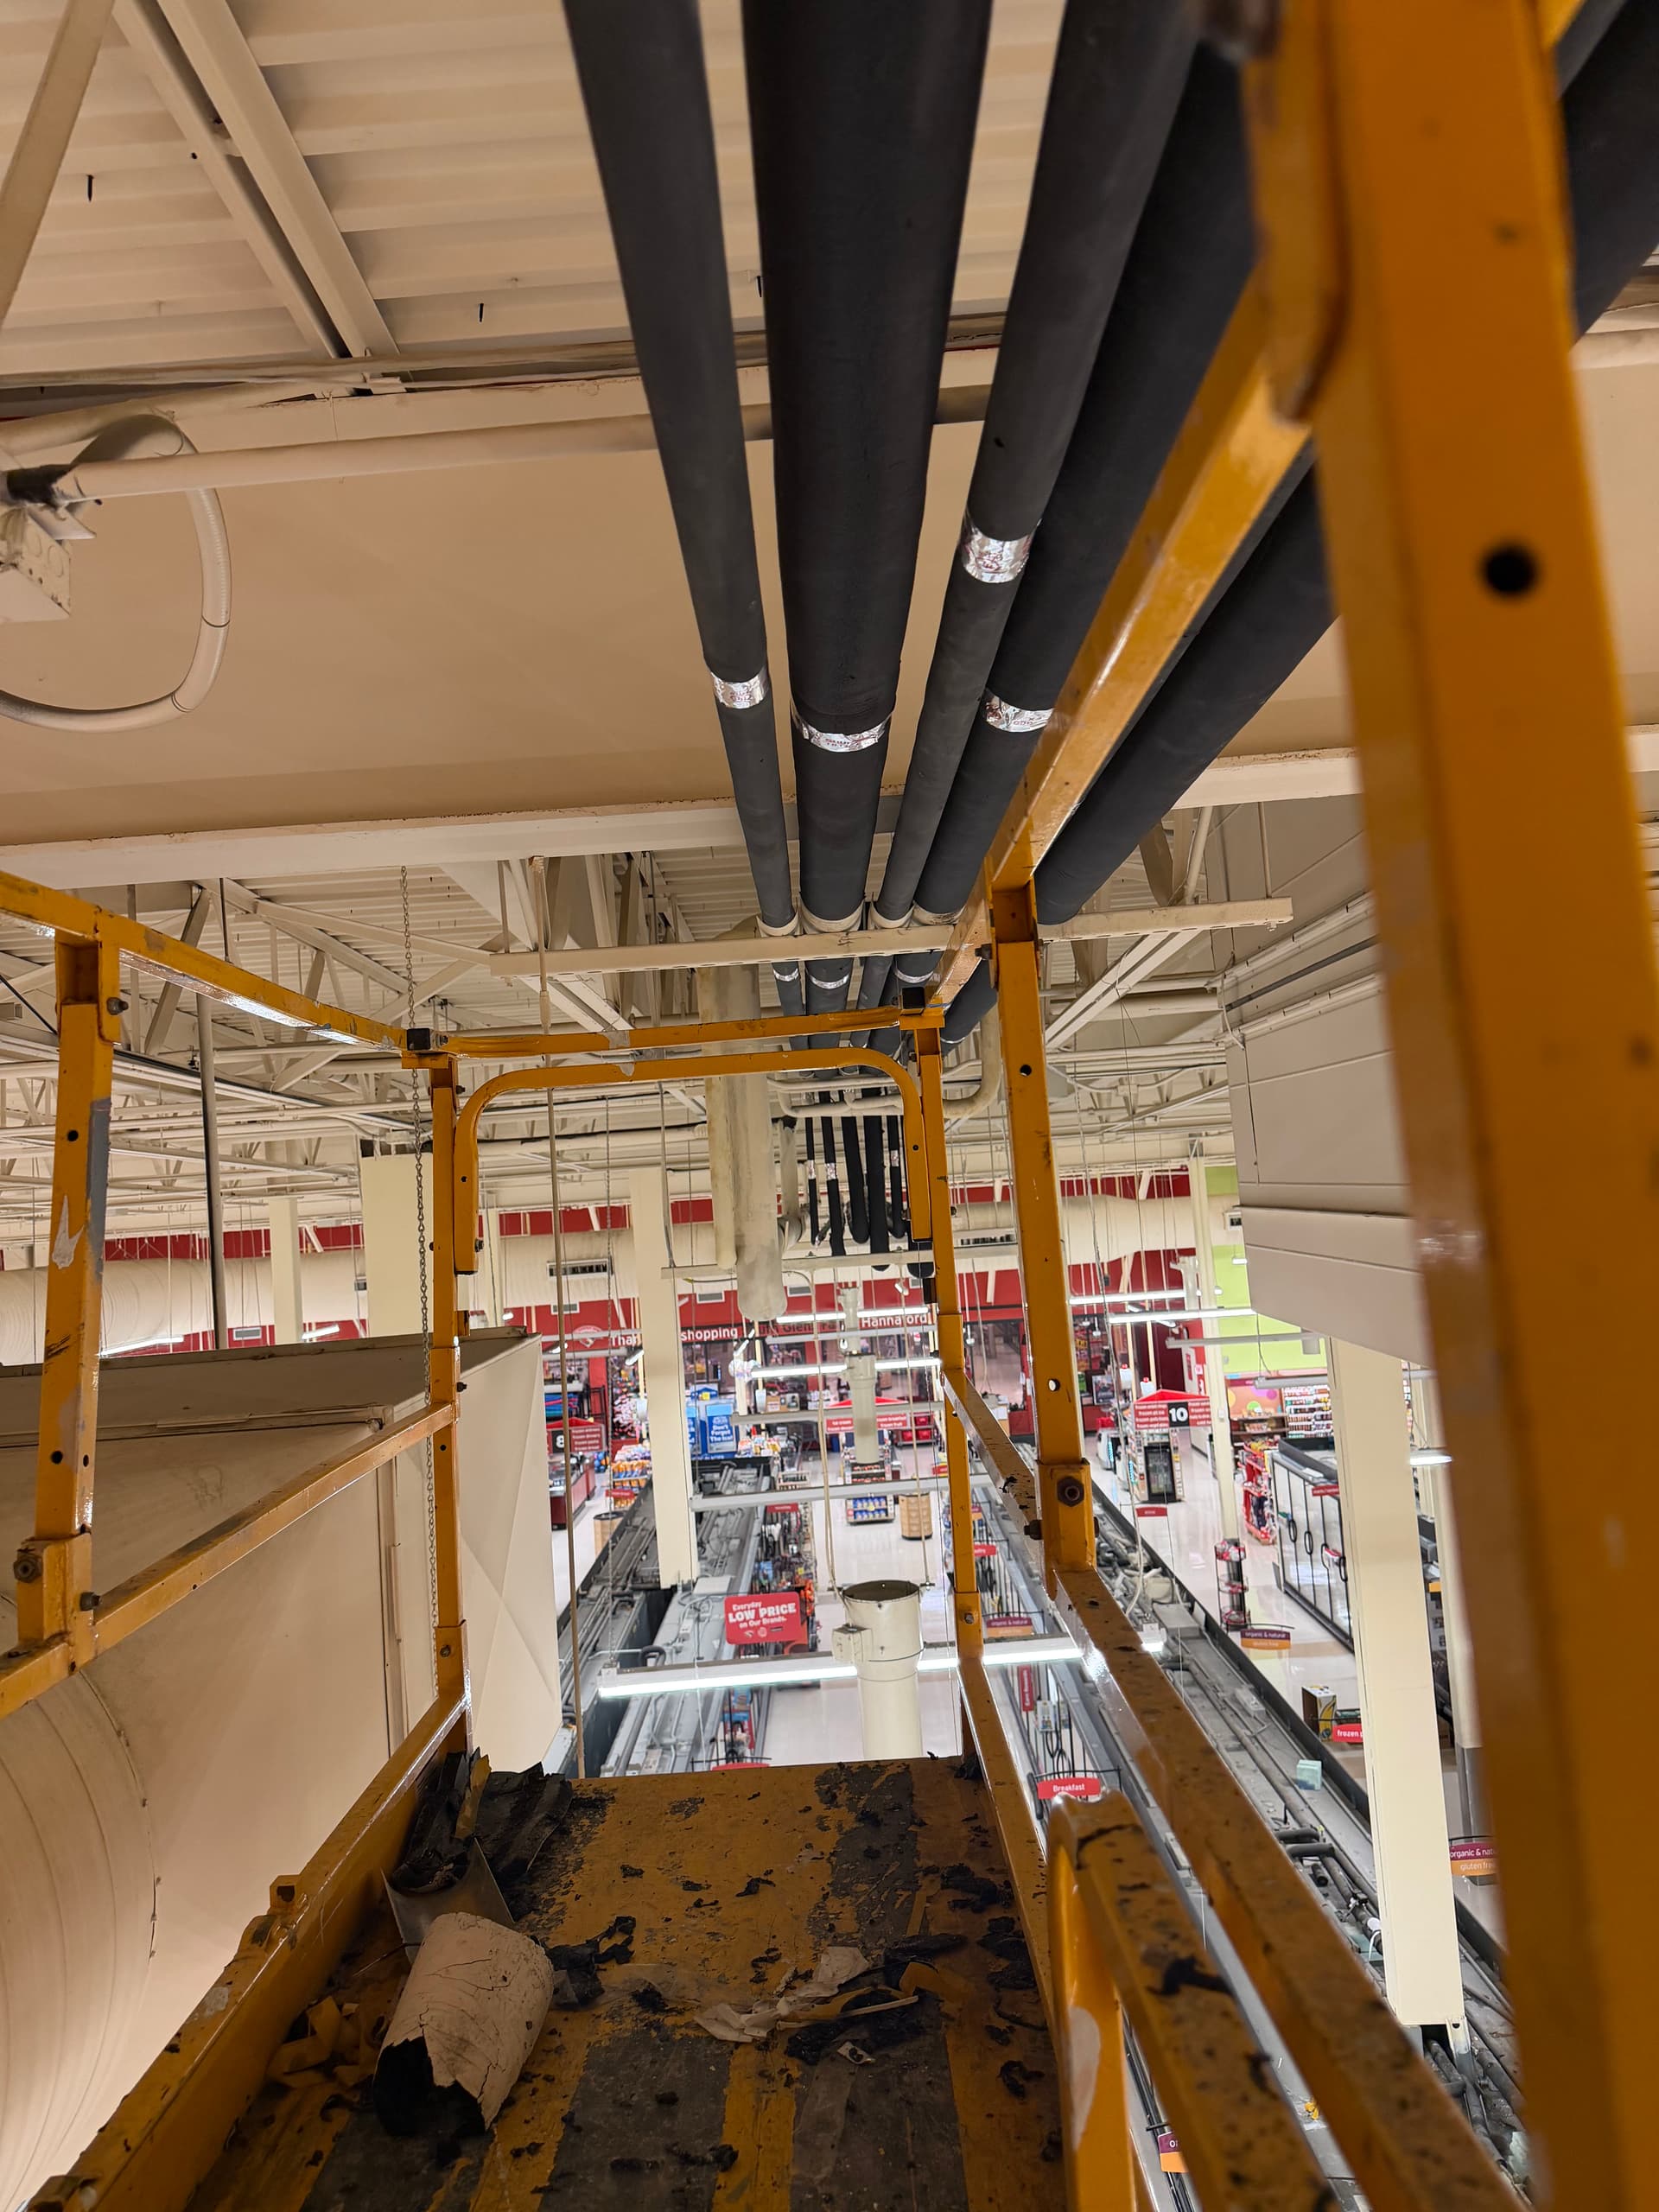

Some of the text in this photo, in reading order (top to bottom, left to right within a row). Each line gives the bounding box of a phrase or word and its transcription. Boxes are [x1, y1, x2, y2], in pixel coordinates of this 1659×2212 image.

[861, 1313, 928, 1328] Hannaord
[681, 1327, 738, 1342] shopping
[611, 1336, 636, 1347] Tha
[1168, 1407, 1189, 1422] 10
[732, 1601, 762, 1611] Everyday
[728, 1603, 796, 1623] LOW PRICE
[1052, 1783, 1085, 1792] Breakfast
[1450, 1849, 1475, 1859] organic
